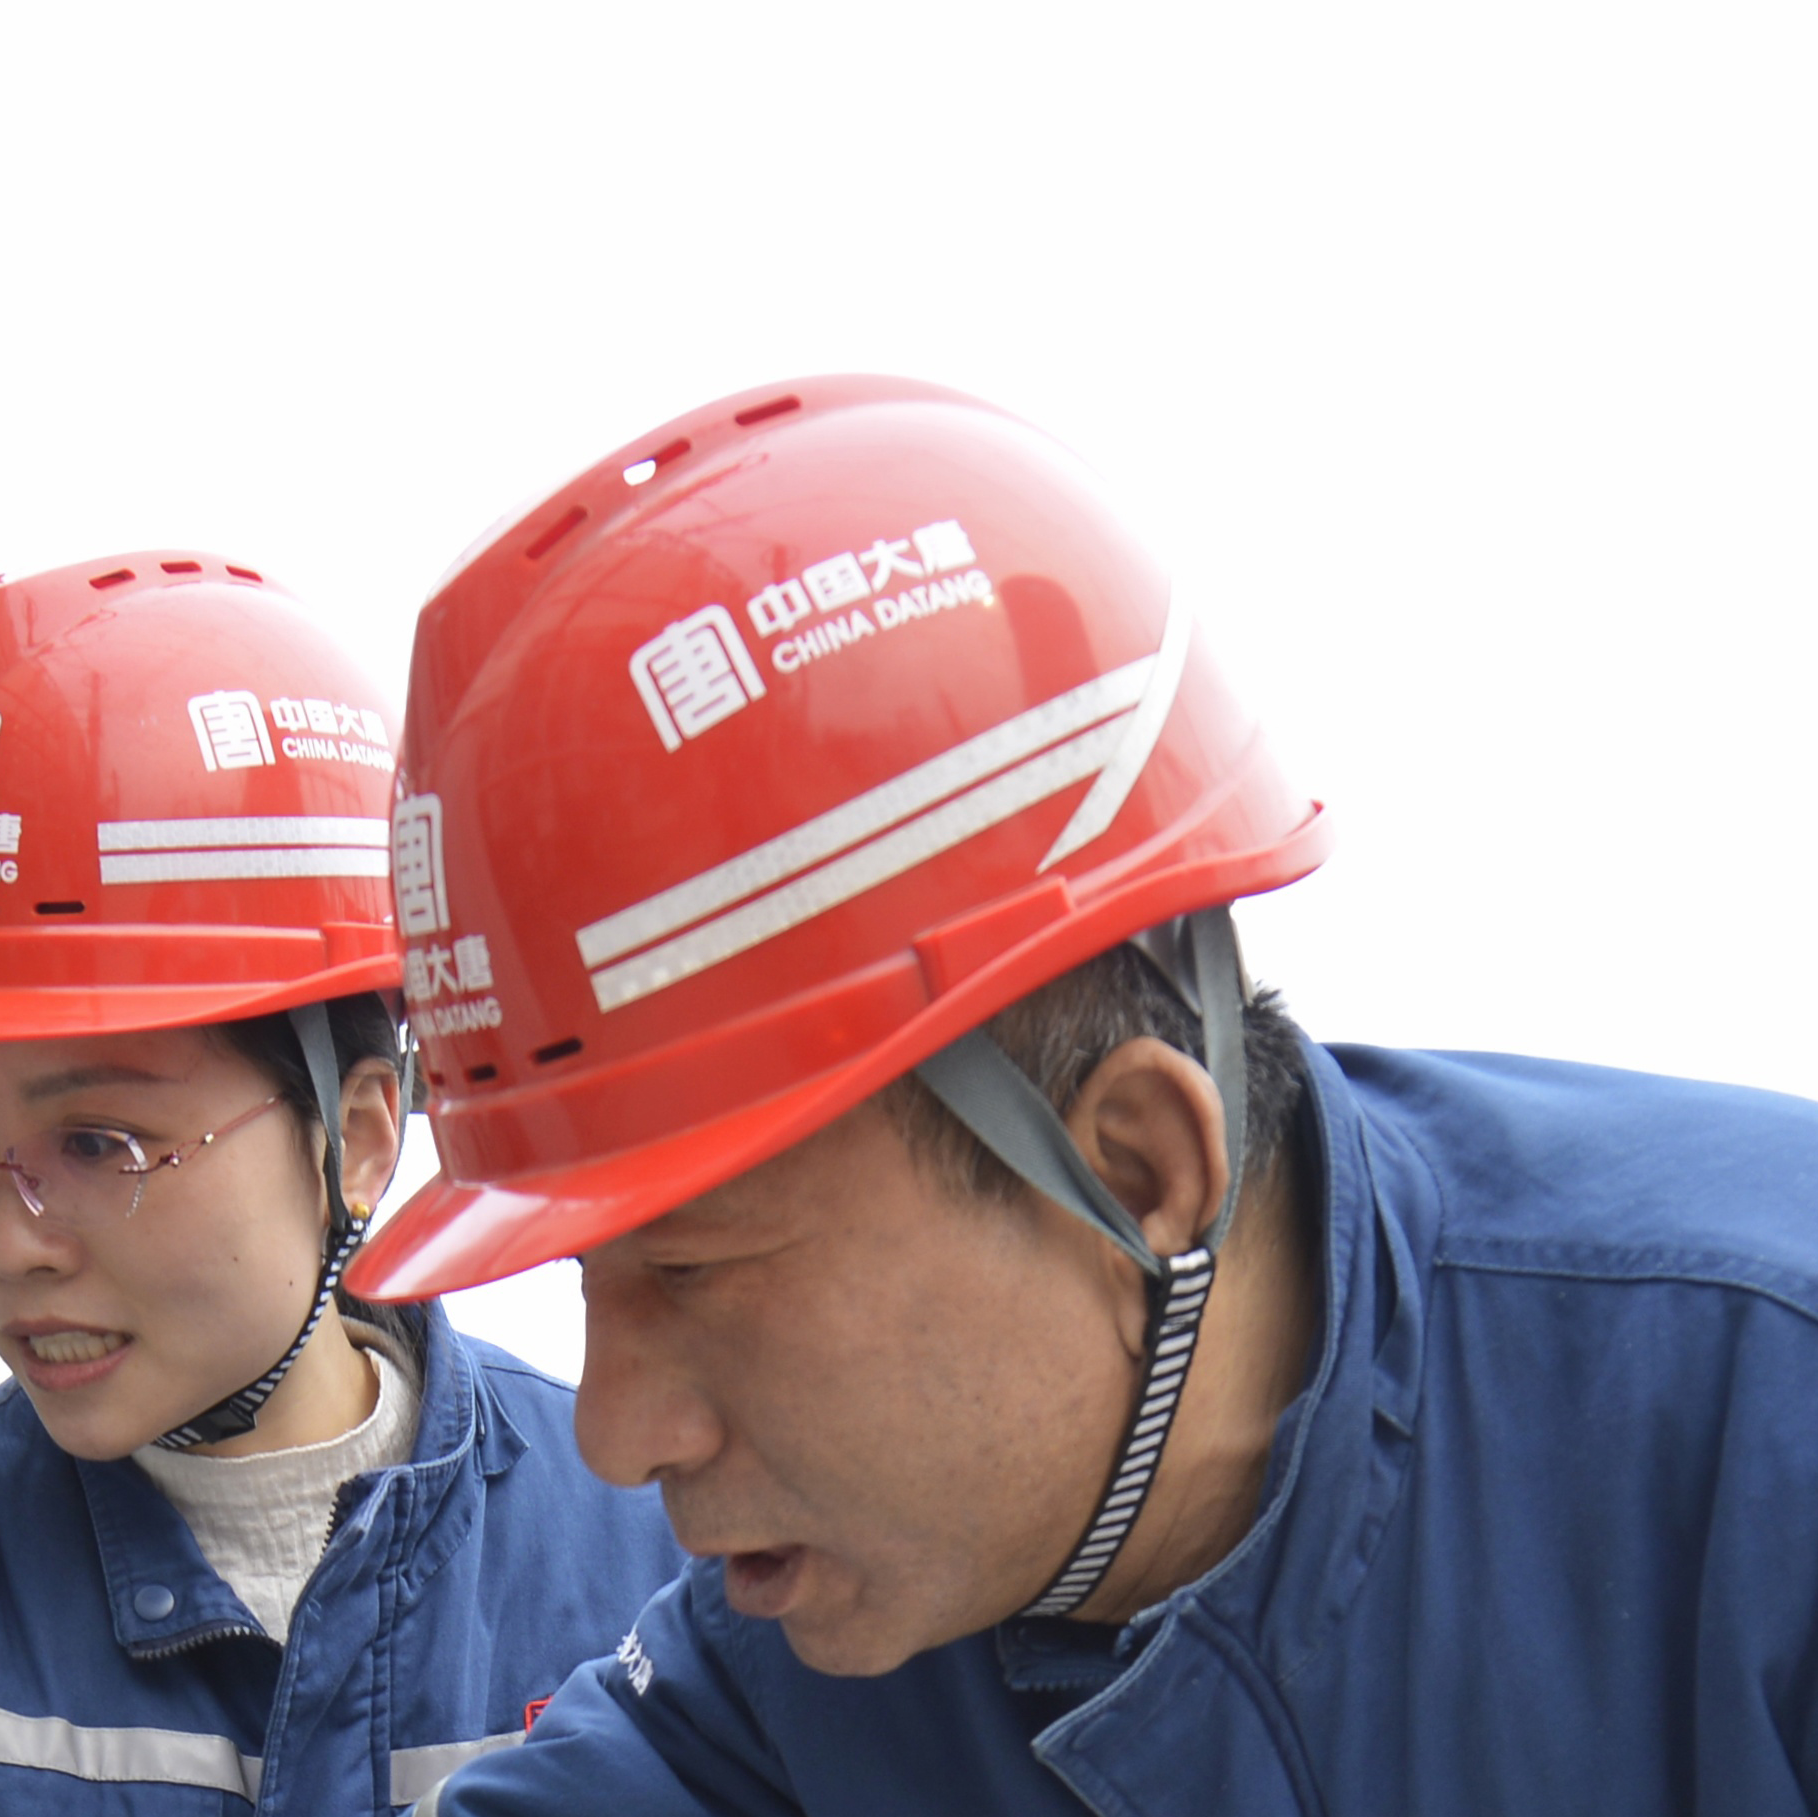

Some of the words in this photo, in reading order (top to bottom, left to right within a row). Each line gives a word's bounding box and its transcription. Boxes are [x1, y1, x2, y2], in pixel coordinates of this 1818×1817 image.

[746, 519, 977, 639] 中国大唐
[771, 609, 876, 674] CHINA
[873, 569, 993, 630] DATANG
[282, 737, 340, 761] CHINA
[404, 934, 494, 1002] 国大唐
